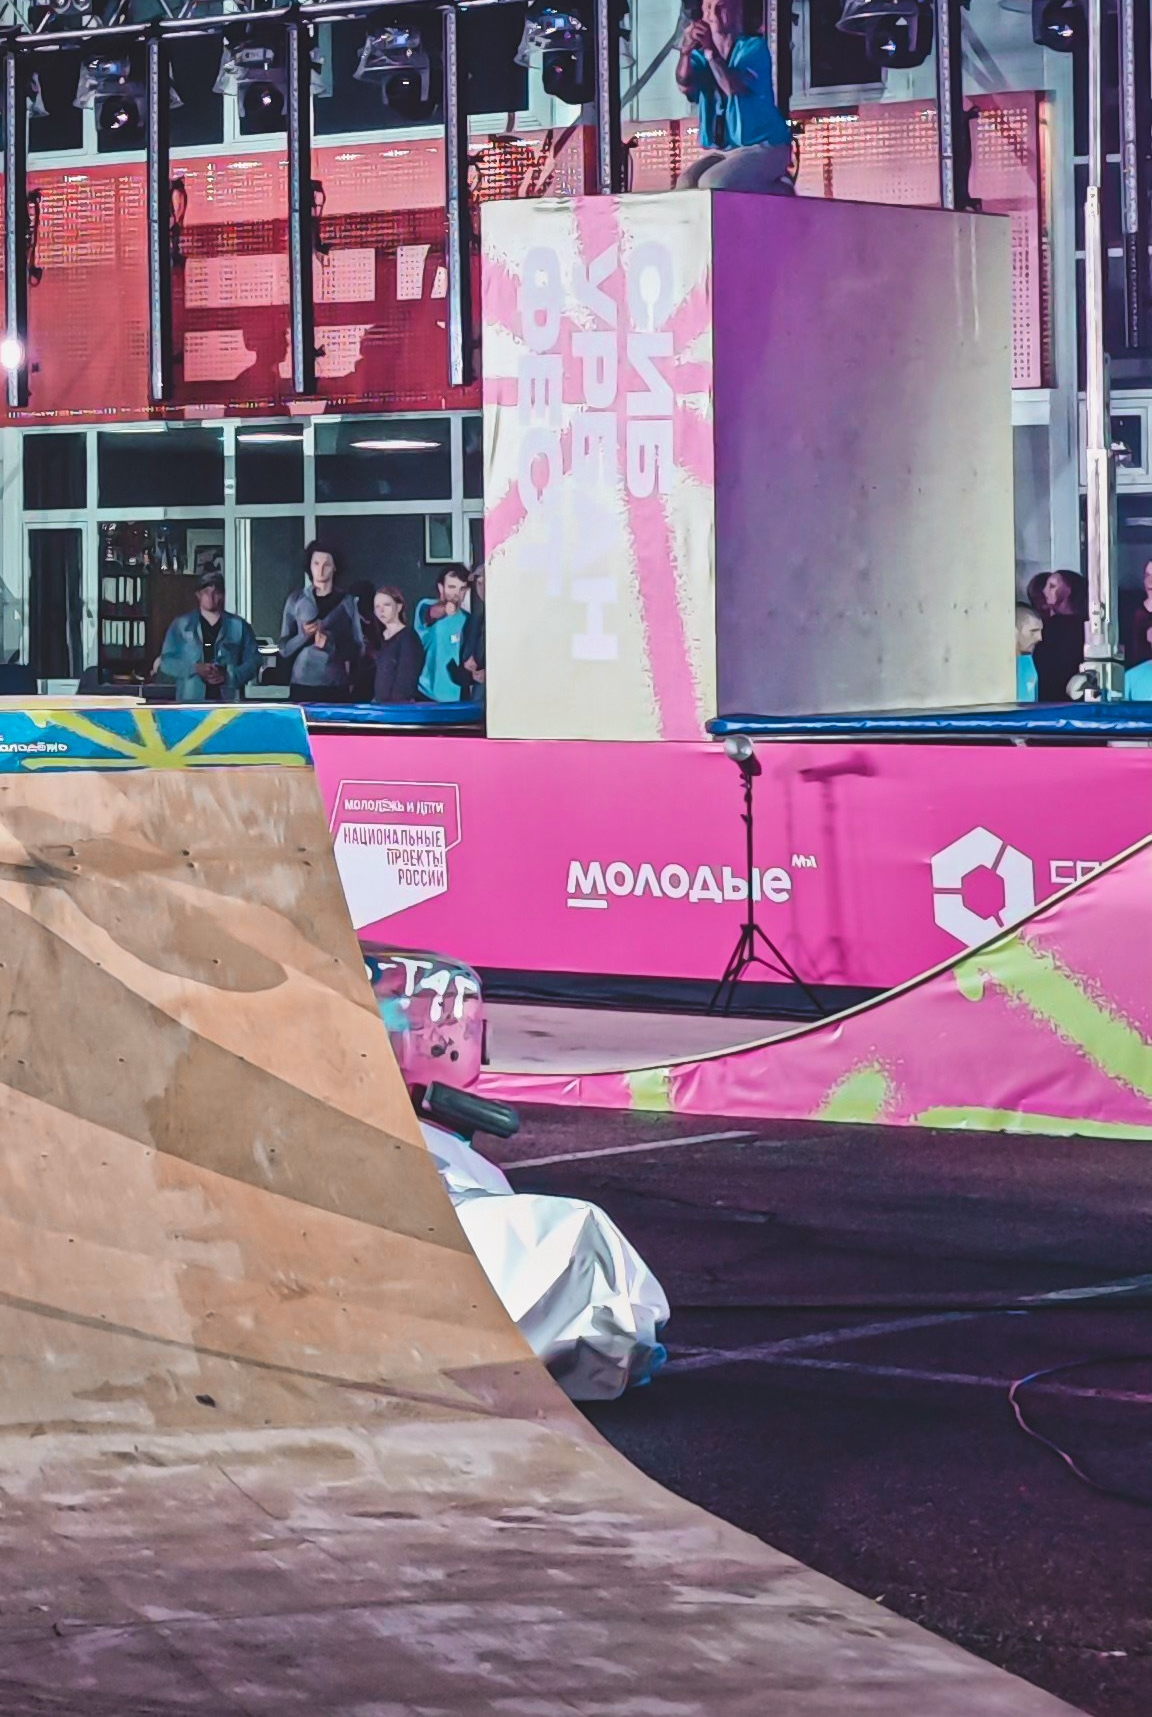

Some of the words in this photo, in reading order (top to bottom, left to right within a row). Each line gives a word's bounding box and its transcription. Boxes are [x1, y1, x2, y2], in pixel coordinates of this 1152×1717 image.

[516, 245, 564, 599] ФЕСТ
[626, 241, 675, 499] СИБ
[570, 243, 619, 661] УРБАН
[343, 826, 443, 848] НАЦИОНАЛЬНЫЕ
[386, 848, 444, 868] ПРОЕКТЫ
[398, 868, 445, 887] РОССИИ
